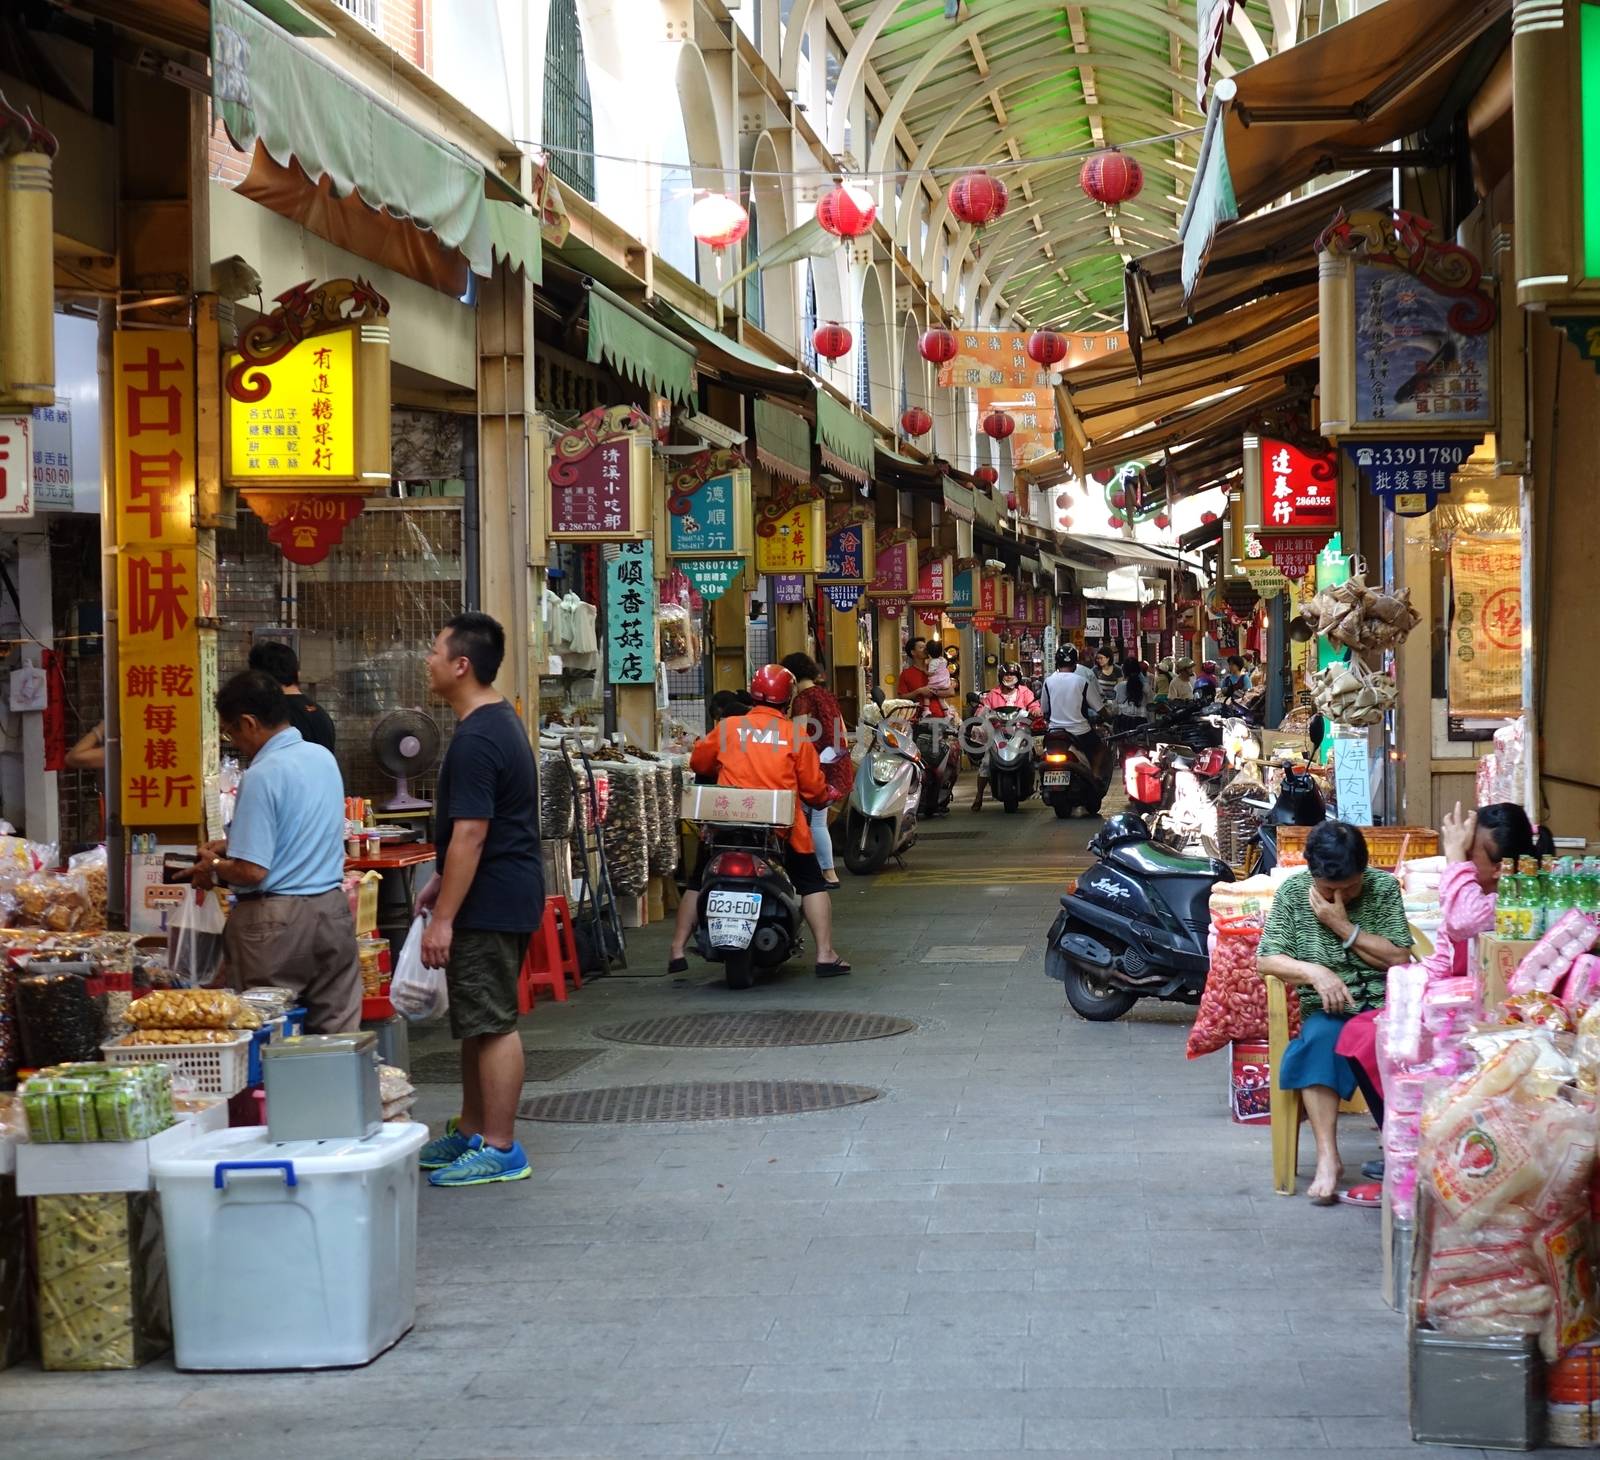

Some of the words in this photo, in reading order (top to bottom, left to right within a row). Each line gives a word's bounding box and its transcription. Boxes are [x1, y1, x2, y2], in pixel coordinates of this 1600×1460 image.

[122, 346, 188, 641] 古早味
[1376, 470, 1446, 490] 批發零售
[1295, 496, 1331, 506] 2860355
[126, 664, 194, 698] 餅乾
[128, 774, 196, 808] 半斤
[1336, 739, 1371, 825] 燒肉粽
